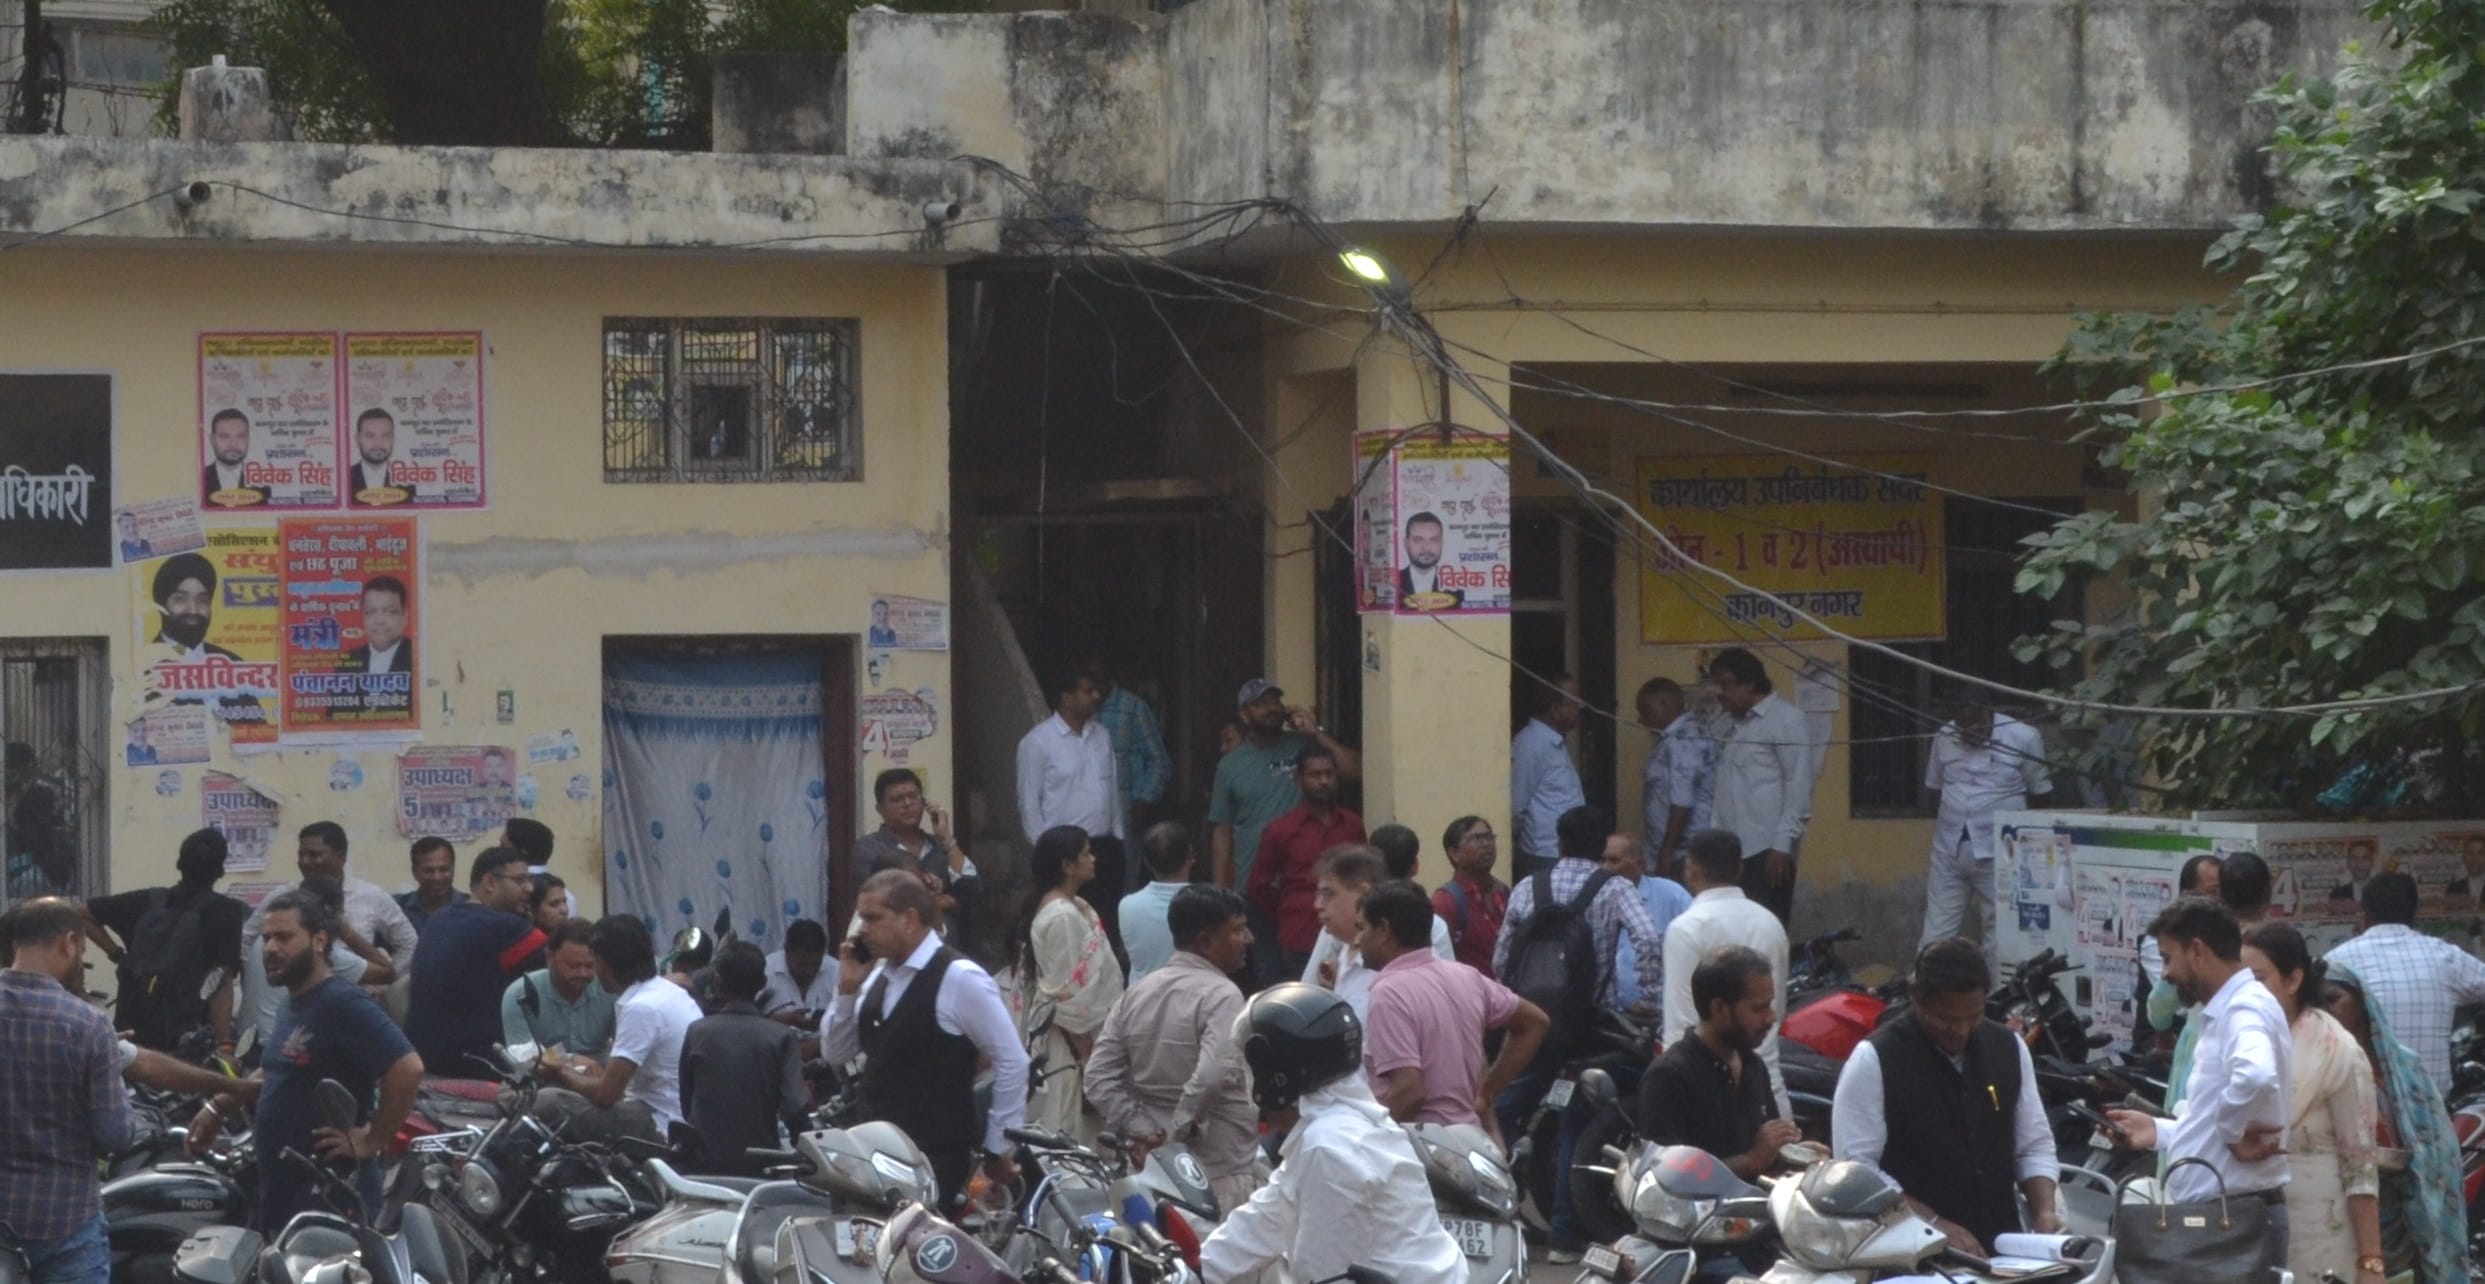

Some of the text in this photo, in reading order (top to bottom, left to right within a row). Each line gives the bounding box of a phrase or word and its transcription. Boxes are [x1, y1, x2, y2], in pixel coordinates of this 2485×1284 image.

[246, 460, 332, 486] विवेक सिंह
[391, 459, 476, 485] विवेक सिंह
[0, 464, 96, 528] धिकारी
[1649, 466, 1747, 510] कार्यालय
[224, 549, 280, 574] संयु
[1735, 532, 1750, 571] 1
[1761, 532, 1780, 567] व
[1789, 530, 1809, 571] 2
[1440, 563, 1510, 588] विवेक सि
[1724, 591, 1864, 629] कानपुर नगर
[288, 616, 341, 650] मंत्री
[153, 656, 279, 690] जसविन्दर
[290, 669, 411, 693] पंचानन यादव
[863, 719, 887, 752] 4
[404, 767, 473, 786] उपाध्यक्ष
[403, 795, 419, 817] 5
[2271, 867, 2295, 914] 4
[1440, 1220, 1483, 1237] P78F
